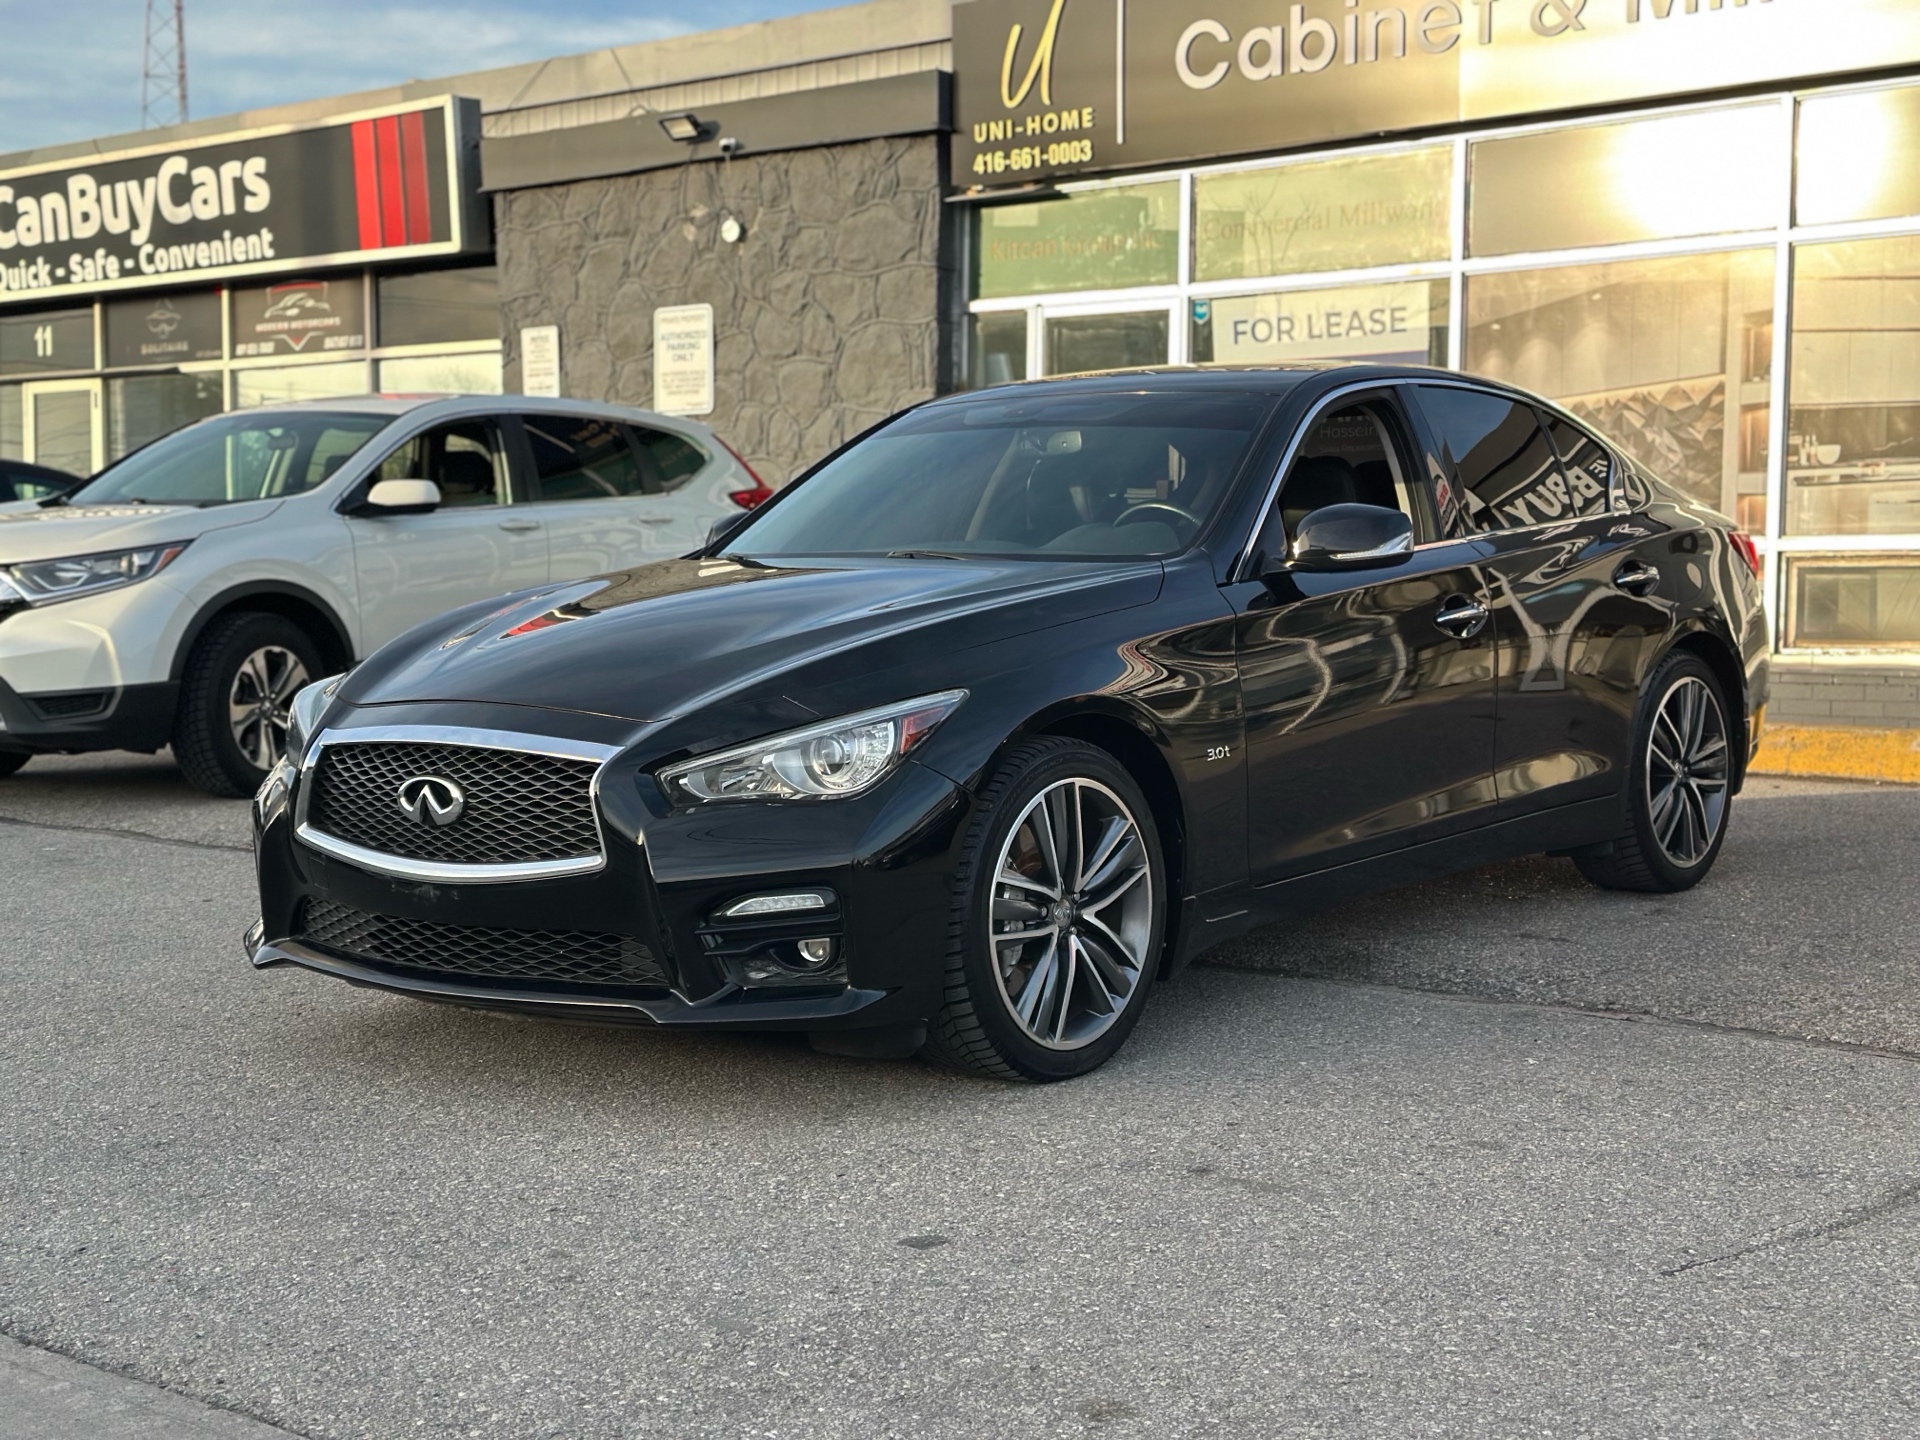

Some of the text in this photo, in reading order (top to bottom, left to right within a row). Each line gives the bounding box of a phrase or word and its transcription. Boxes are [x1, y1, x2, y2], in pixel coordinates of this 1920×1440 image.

[1175, 0, 1499, 89] Cabinet
[973, 106, 1094, 144] UNI-HOME
[972, 139, 1093, 174] 416-661-0003
[0, 156, 271, 249] CanBuyCars
[69, 248, 120, 284] Safe
[138, 227, 275, 275] Convenient
[34, 325, 52, 357] 11
[1233, 306, 1408, 346] FOR LEASE
[1207, 745, 1231, 761] 3.0t
